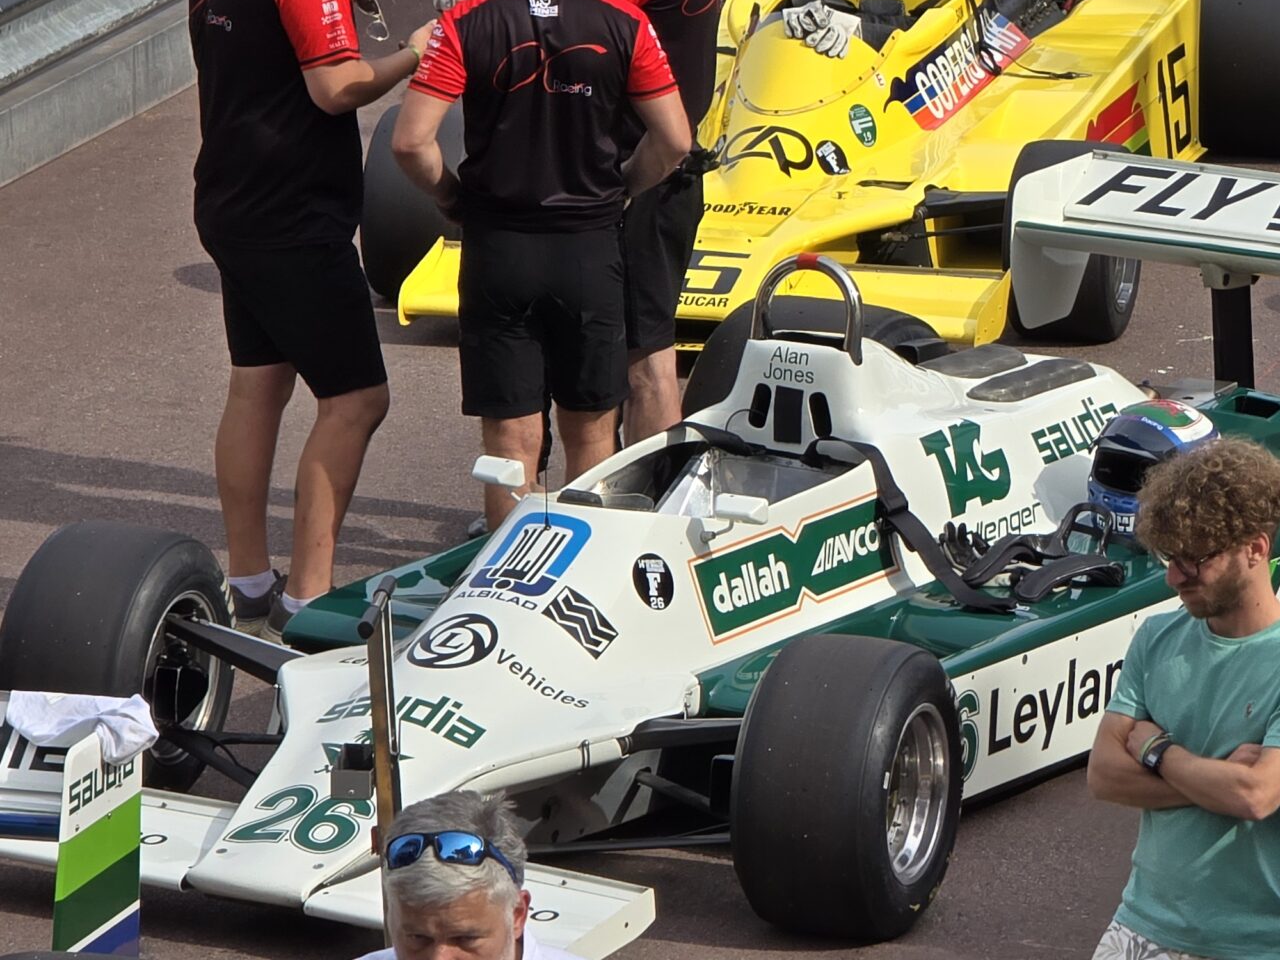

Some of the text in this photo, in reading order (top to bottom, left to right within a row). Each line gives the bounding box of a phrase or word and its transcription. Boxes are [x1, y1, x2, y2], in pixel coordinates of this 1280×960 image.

[552, 79, 592, 96] Racing
[1157, 42, 1192, 159] 15
[703, 200, 792, 217] OODYEAR
[1075, 165, 1280, 220] FLY
[678, 294, 729, 308] SUCAR
[762, 361, 815, 384] Jones
[770, 345, 809, 366] Alan
[453, 589, 538, 611] ALBILAD
[650, 596, 665, 609] 26
[712, 552, 791, 615] dallah
[496, 648, 590, 709] Vehicles
[315, 695, 487, 749] sadia
[987, 657, 1124, 756] Leylan
[222, 783, 376, 854] 26
